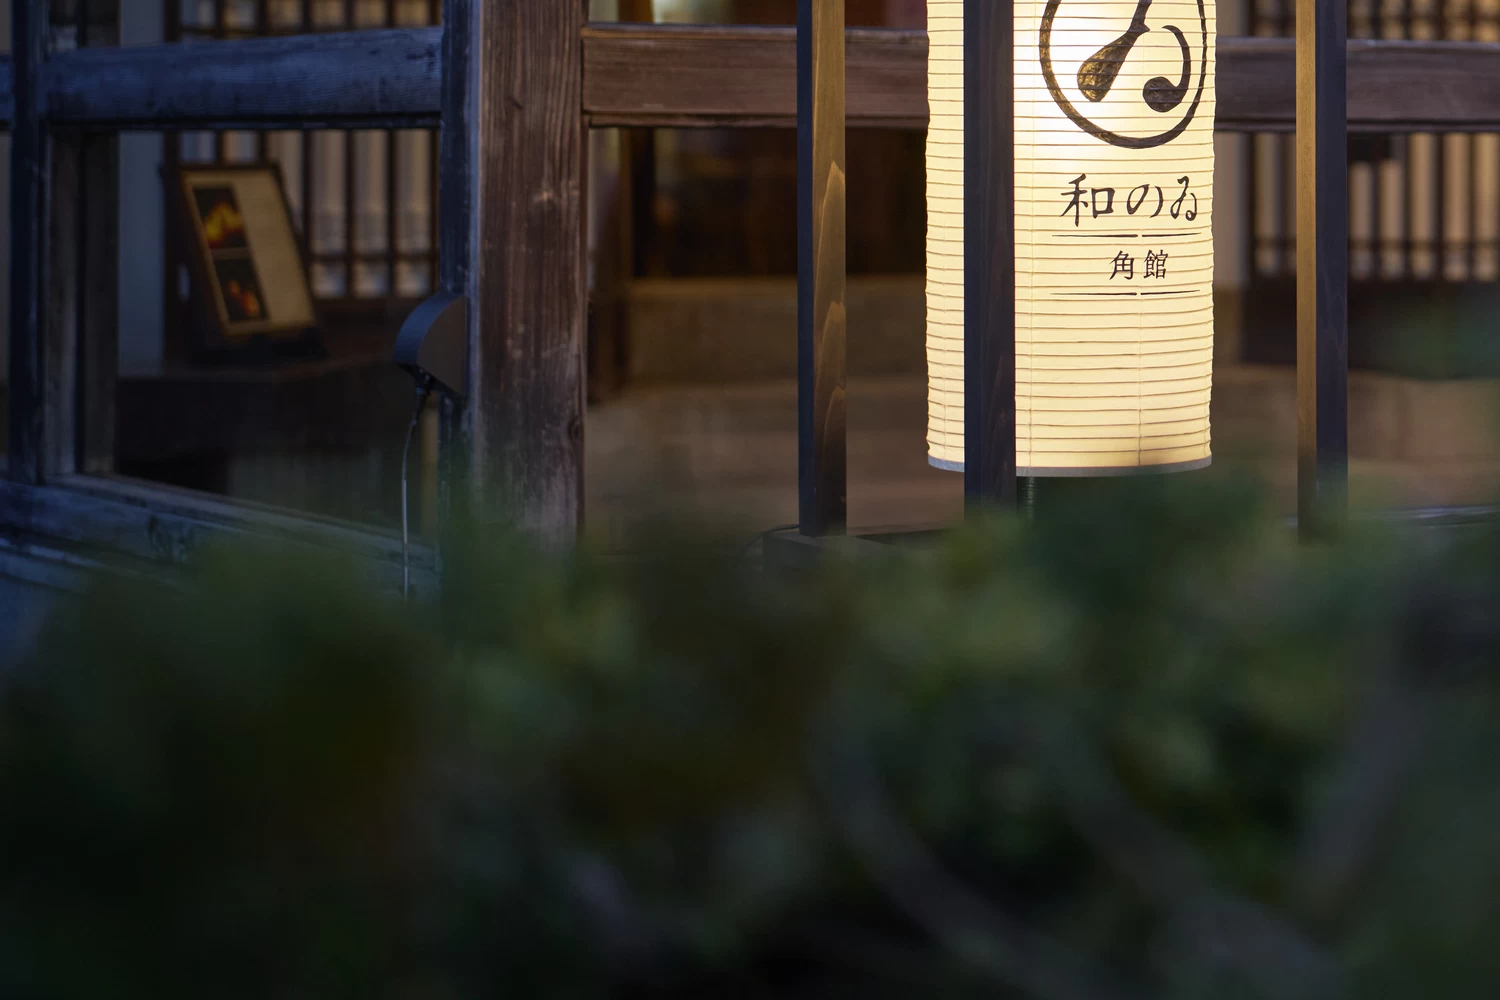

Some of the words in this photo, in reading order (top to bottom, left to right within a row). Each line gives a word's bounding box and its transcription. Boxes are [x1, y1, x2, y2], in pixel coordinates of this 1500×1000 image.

[1059, 173, 1198, 227] 和のゐ
[1109, 249, 1169, 280] 角館
